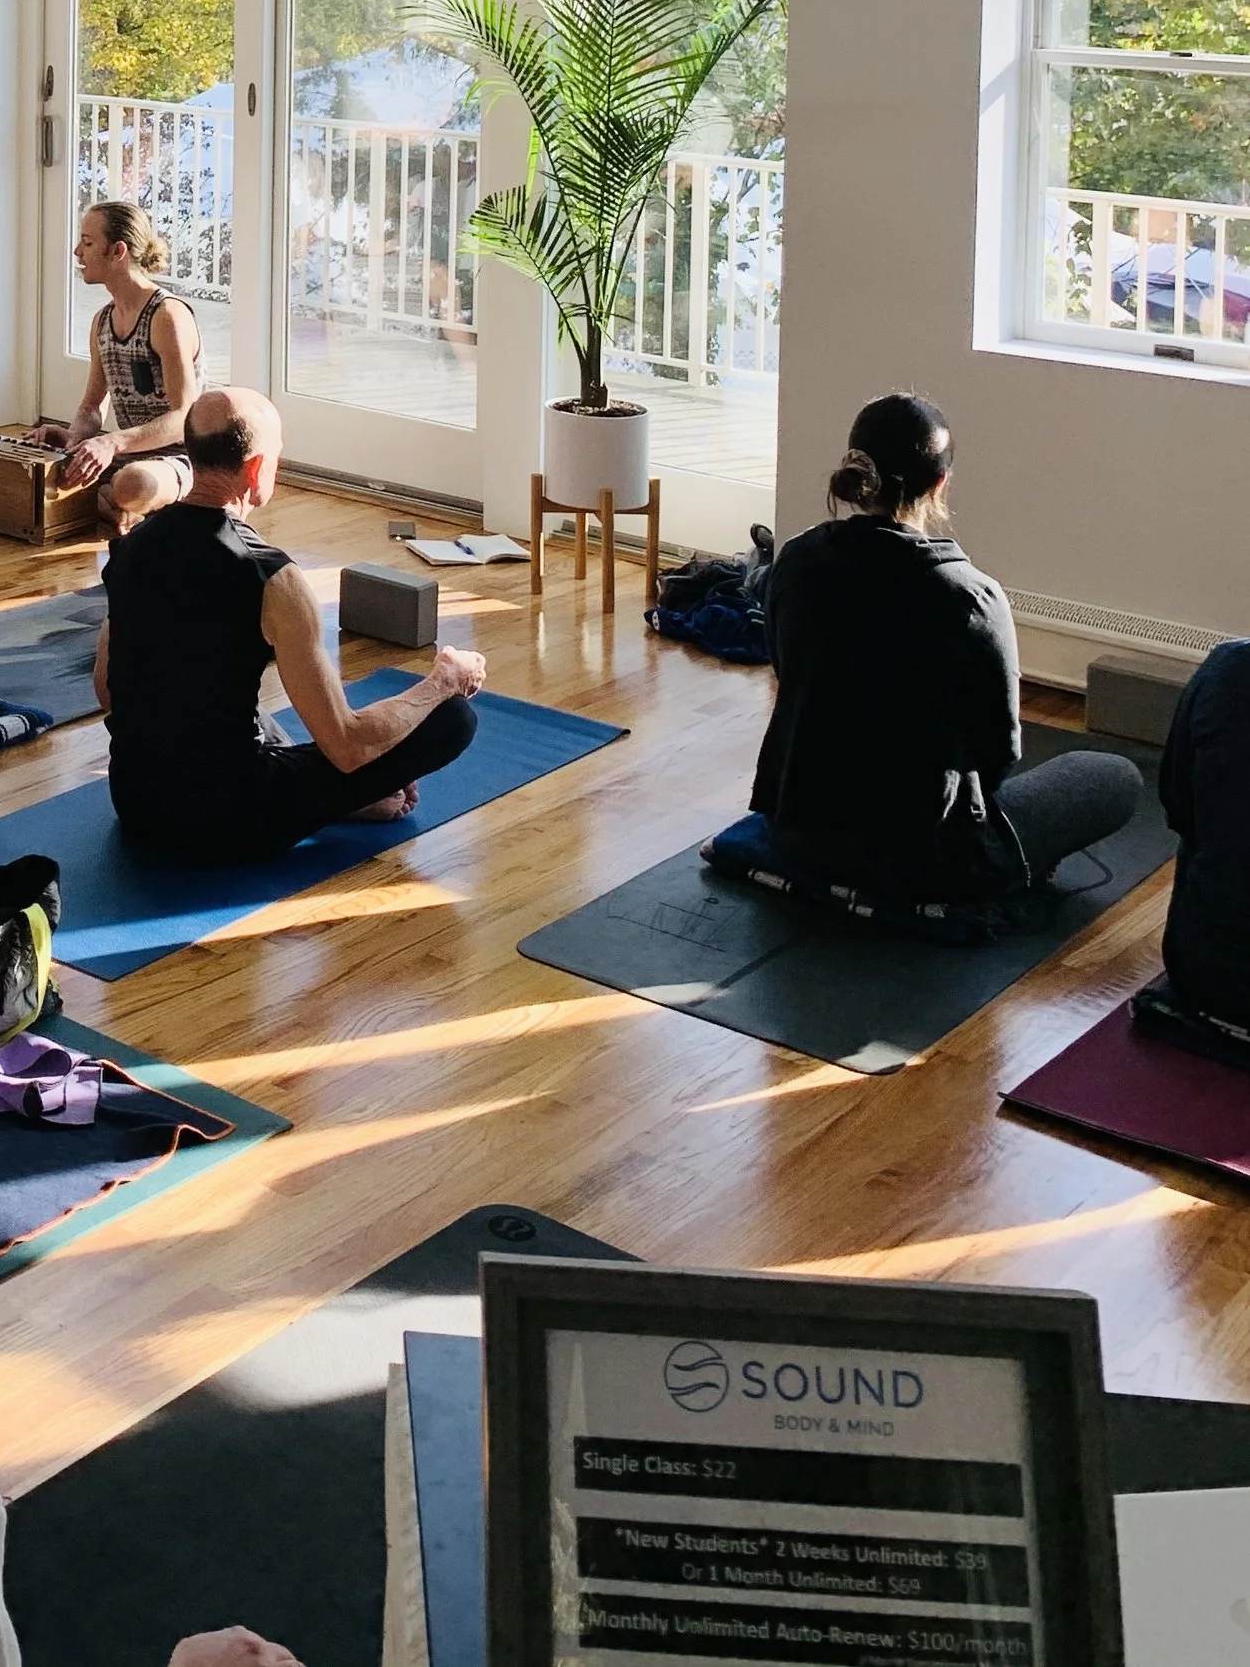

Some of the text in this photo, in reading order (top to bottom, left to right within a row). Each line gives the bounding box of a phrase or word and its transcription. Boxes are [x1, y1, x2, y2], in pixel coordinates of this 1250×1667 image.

[742, 1360, 924, 1409] SOUND
[773, 1414, 895, 1437] BODY & MIND
[582, 1452, 737, 1479] Single Class: $22
[775, 1540, 786, 1558] 2
[791, 1542, 850, 1562] Weeks
[855, 1546, 949, 1568] Unlimited:
[681, 1562, 704, 1581] Or
[709, 1565, 720, 1582] 1
[723, 1566, 784, 1586] Month
[788, 1571, 883, 1593] Unlimited:
[674, 1613, 771, 1639] Unlimited
